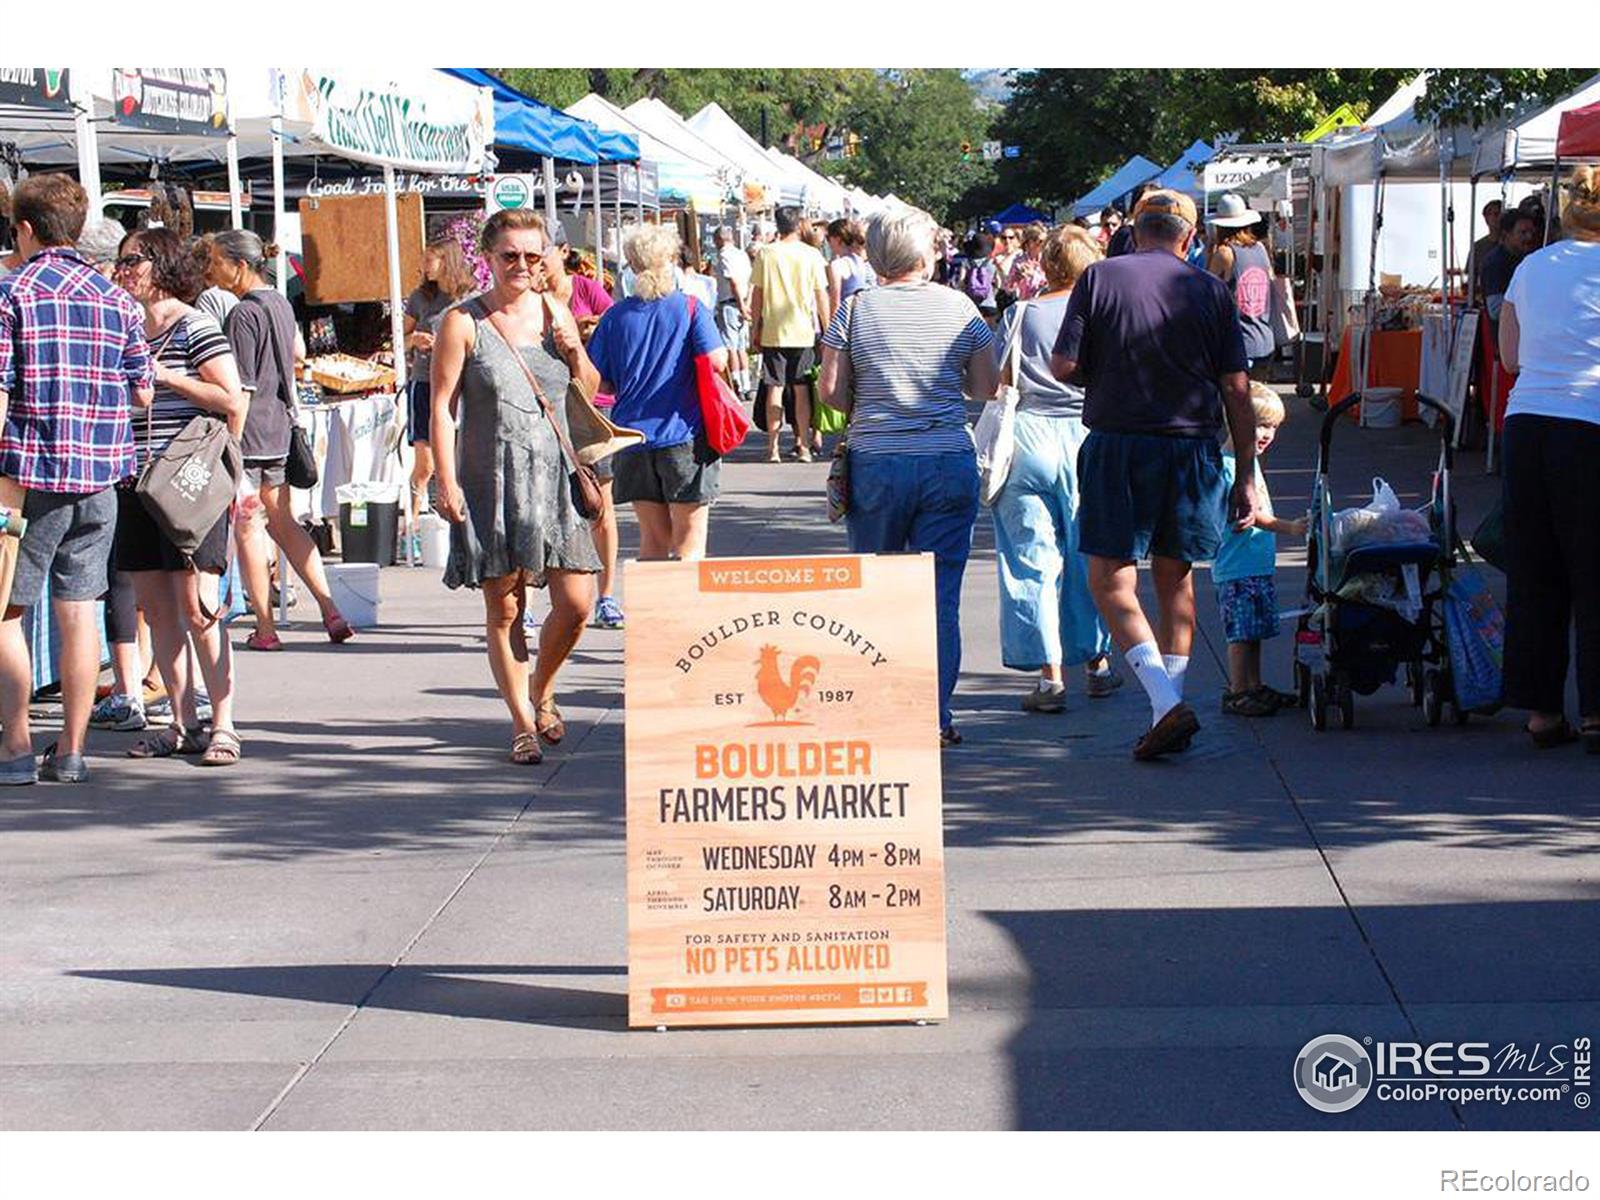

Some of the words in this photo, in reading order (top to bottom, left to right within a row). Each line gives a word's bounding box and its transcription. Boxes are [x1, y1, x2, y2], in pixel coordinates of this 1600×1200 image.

[306, 176, 355, 197] Good
[439, 173, 471, 193] the
[710, 567, 815, 585] WELCOME
[824, 567, 851, 583] TO
[675, 610, 781, 674] BOULDER
[792, 611, 888, 669] COUNTY
[715, 693, 744, 706] EST
[818, 690, 854, 704] 1987
[695, 741, 871, 779] BOULDER
[659, 786, 786, 823] FARMERS
[797, 783, 910, 820] MARKET
[702, 844, 816, 871] WEDNESDAY
[828, 843, 864, 868] 4PM
[884, 842, 921, 867] 8PM
[703, 885, 800, 912] SATURDAY
[829, 884, 867, 909] 8AM
[886, 883, 921, 908] 2PM
[685, 934, 711, 946] FOR
[717, 933, 767, 944] SAFETY
[772, 932, 800, 943] AND
[806, 930, 890, 941] SANITATION
[686, 947, 717, 974] NO
[725, 945, 778, 973] PETS
[786, 943, 891, 972] ALLOWED
